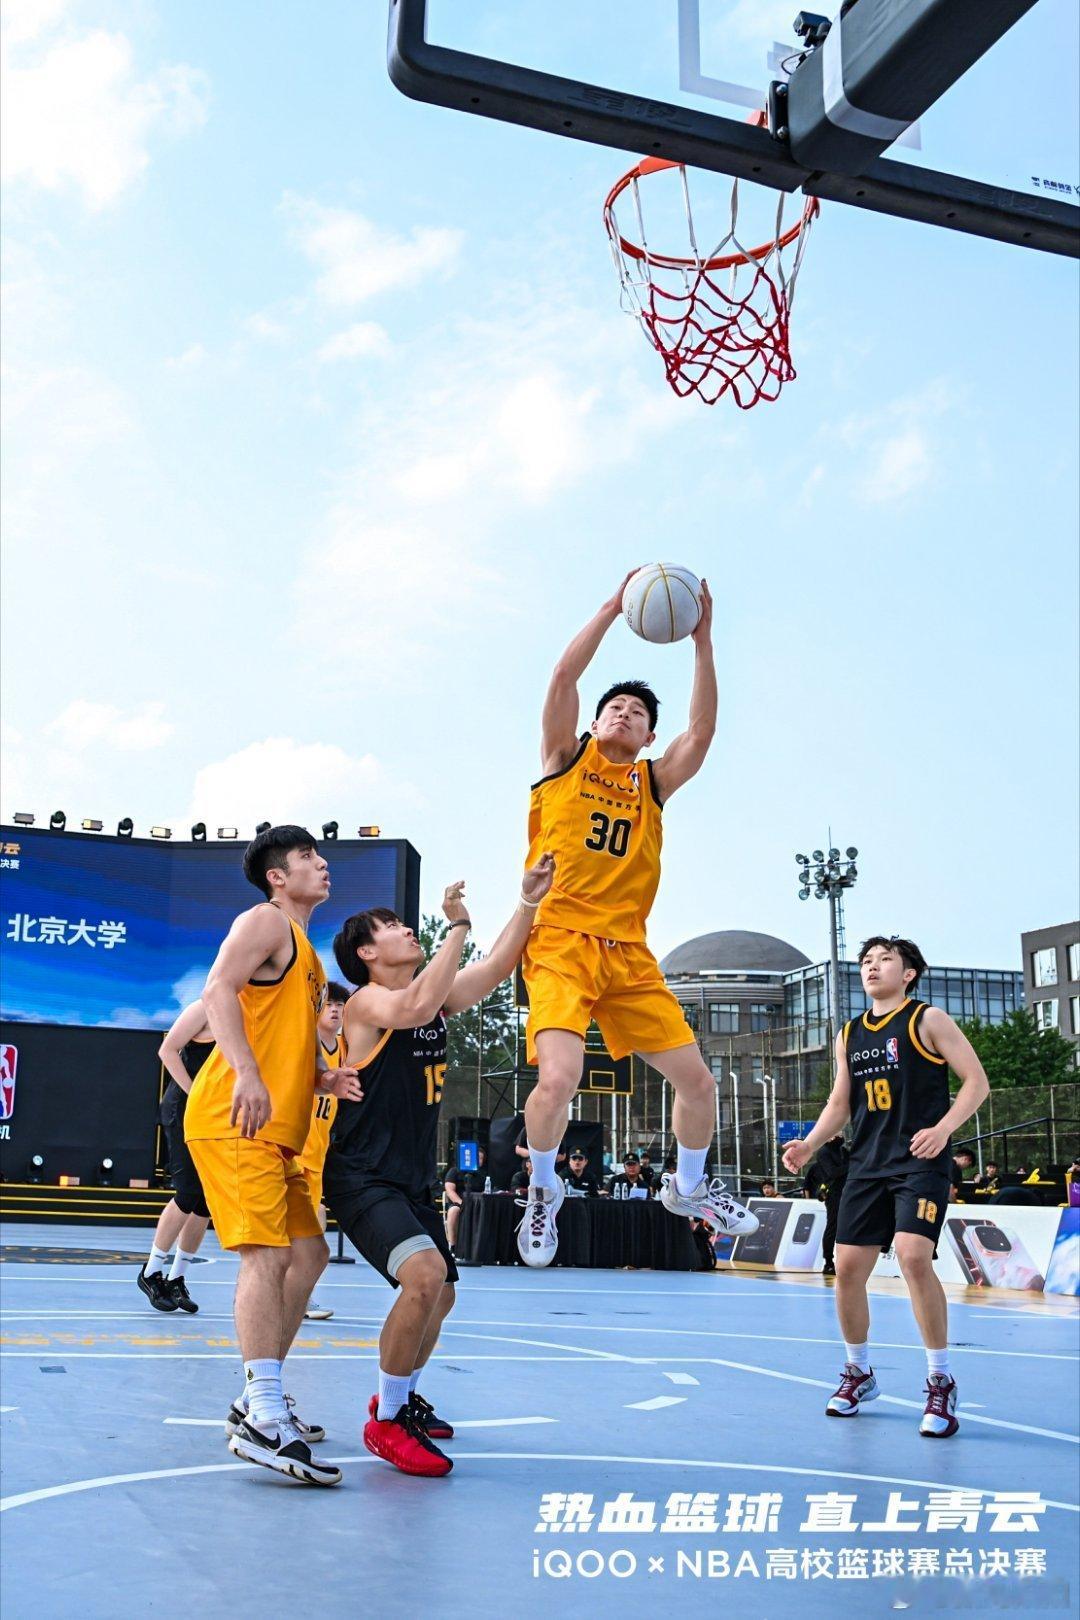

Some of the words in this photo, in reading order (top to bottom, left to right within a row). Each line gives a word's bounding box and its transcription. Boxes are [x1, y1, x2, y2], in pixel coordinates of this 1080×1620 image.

[584, 811, 632, 858] 30
[7, 913, 127, 949] 北京大学
[850, 1048, 880, 1063] iQOO
[864, 1079, 893, 1112] 18
